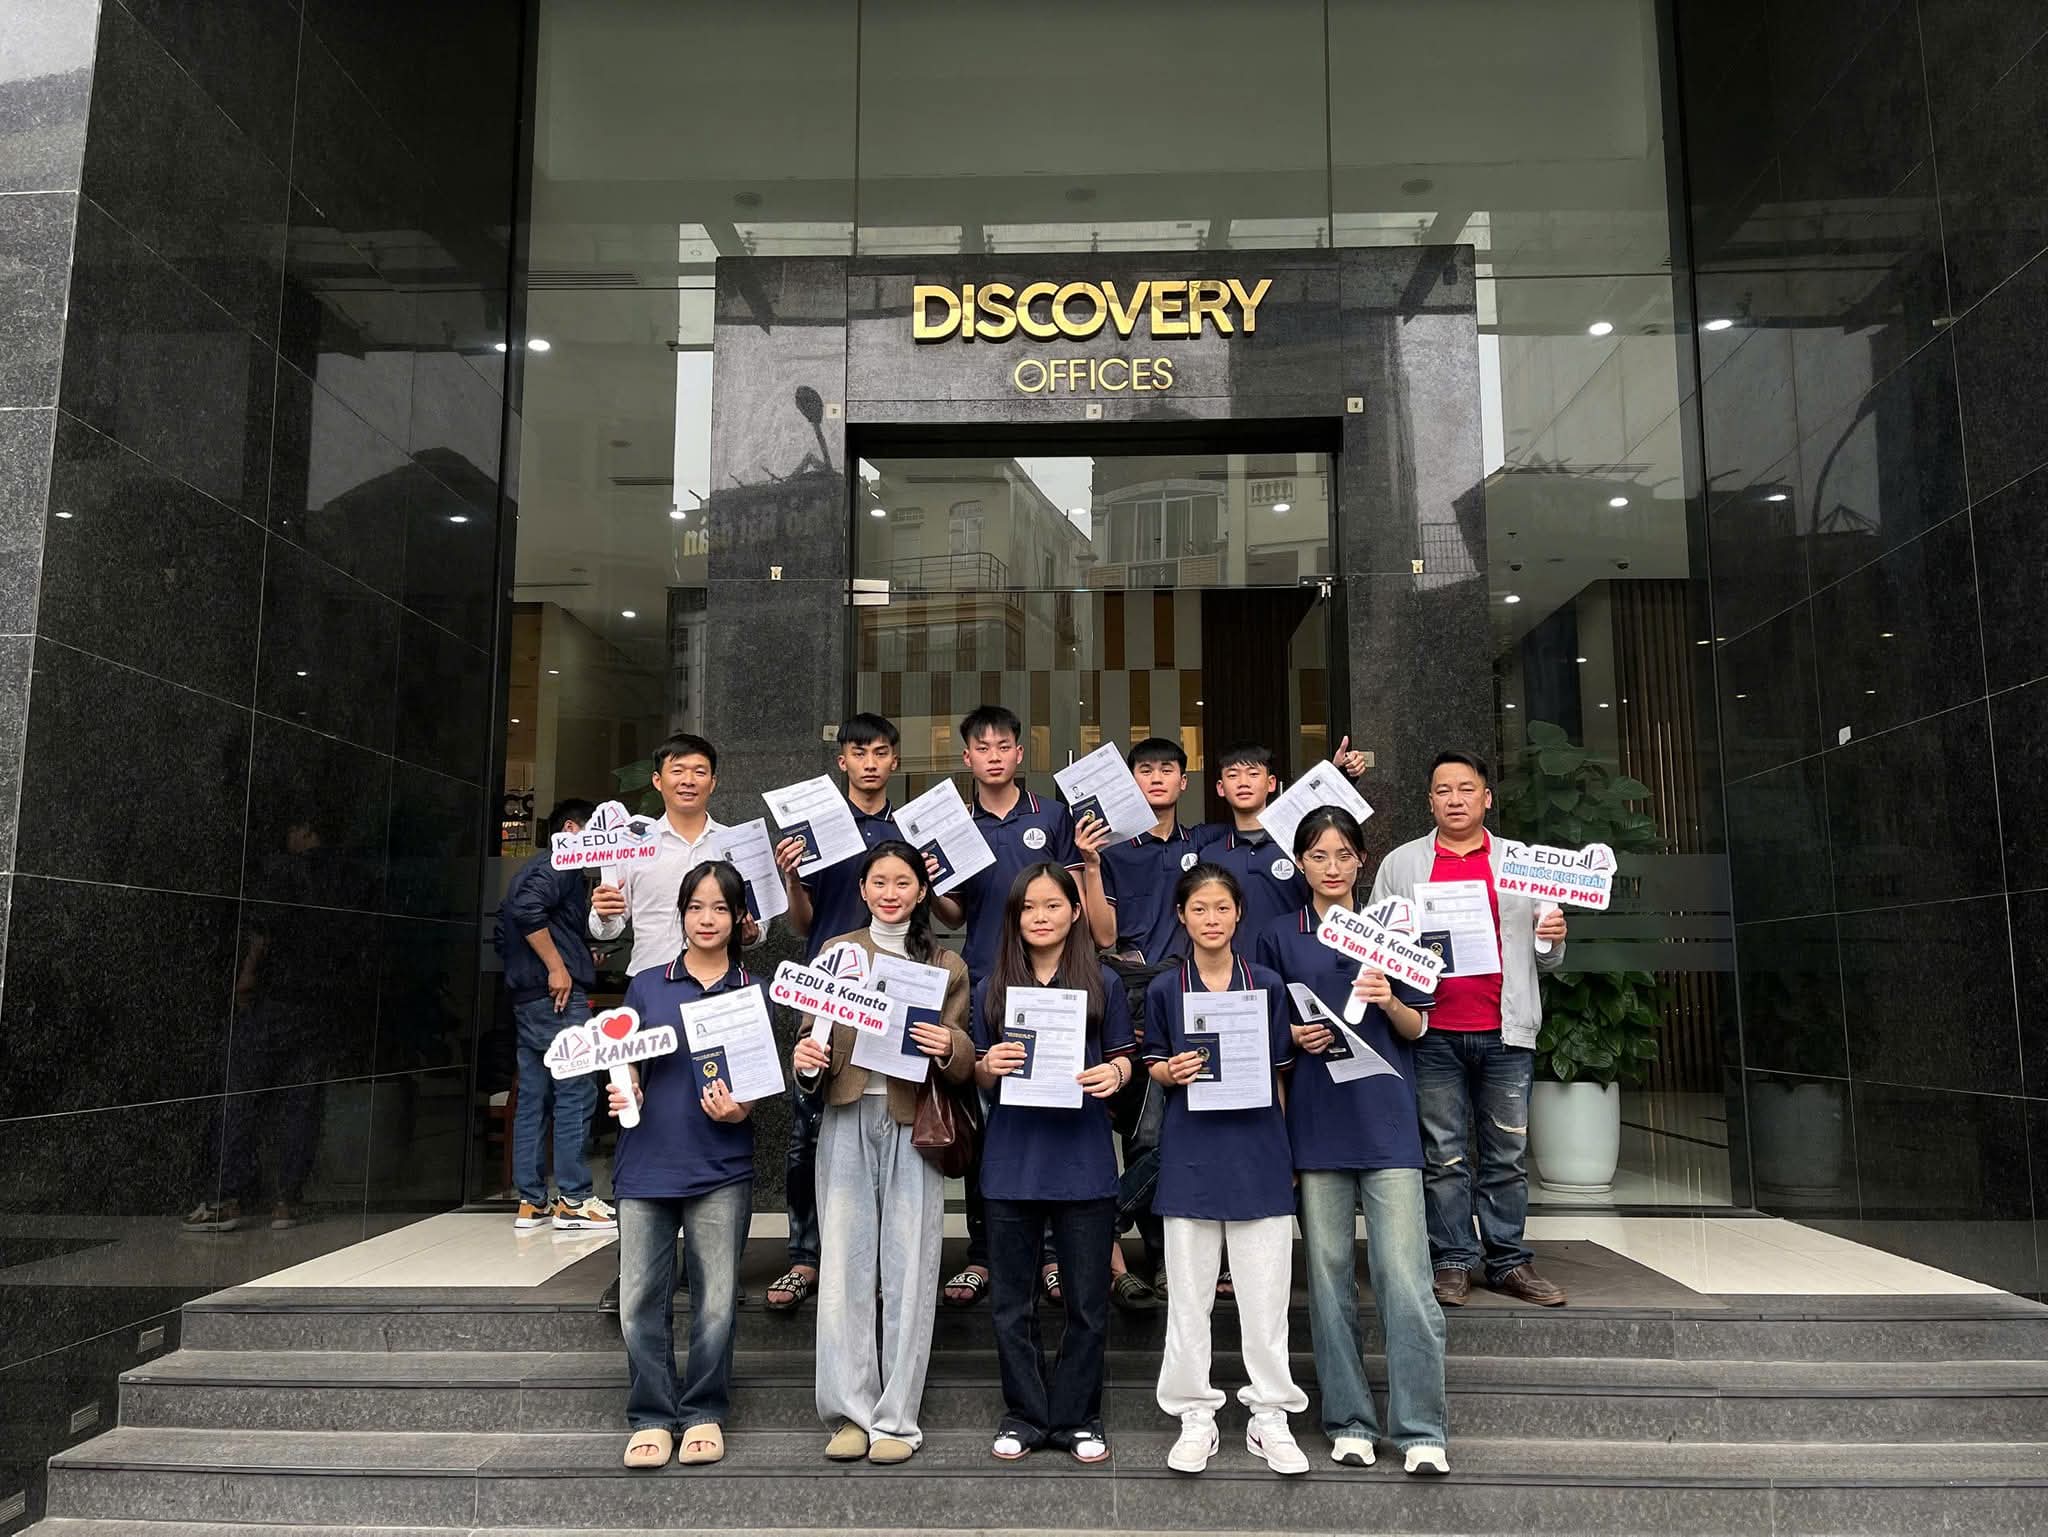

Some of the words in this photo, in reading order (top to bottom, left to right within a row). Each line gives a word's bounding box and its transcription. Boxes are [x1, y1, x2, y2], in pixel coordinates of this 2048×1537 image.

[913, 279, 1273, 343] DISCOVERY
[1013, 357, 1174, 393] OFFICES
[1499, 878, 1527, 891] BAY
[1330, 911, 1375, 938] K-EDU
[1374, 932, 1386, 946] &
[1387, 939, 1437, 970] Kanata
[780, 967, 824, 990] K-EDU
[824, 982, 836, 995] &
[837, 985, 888, 1012] Kanata
[594, 1032, 672, 1065] KANATA
